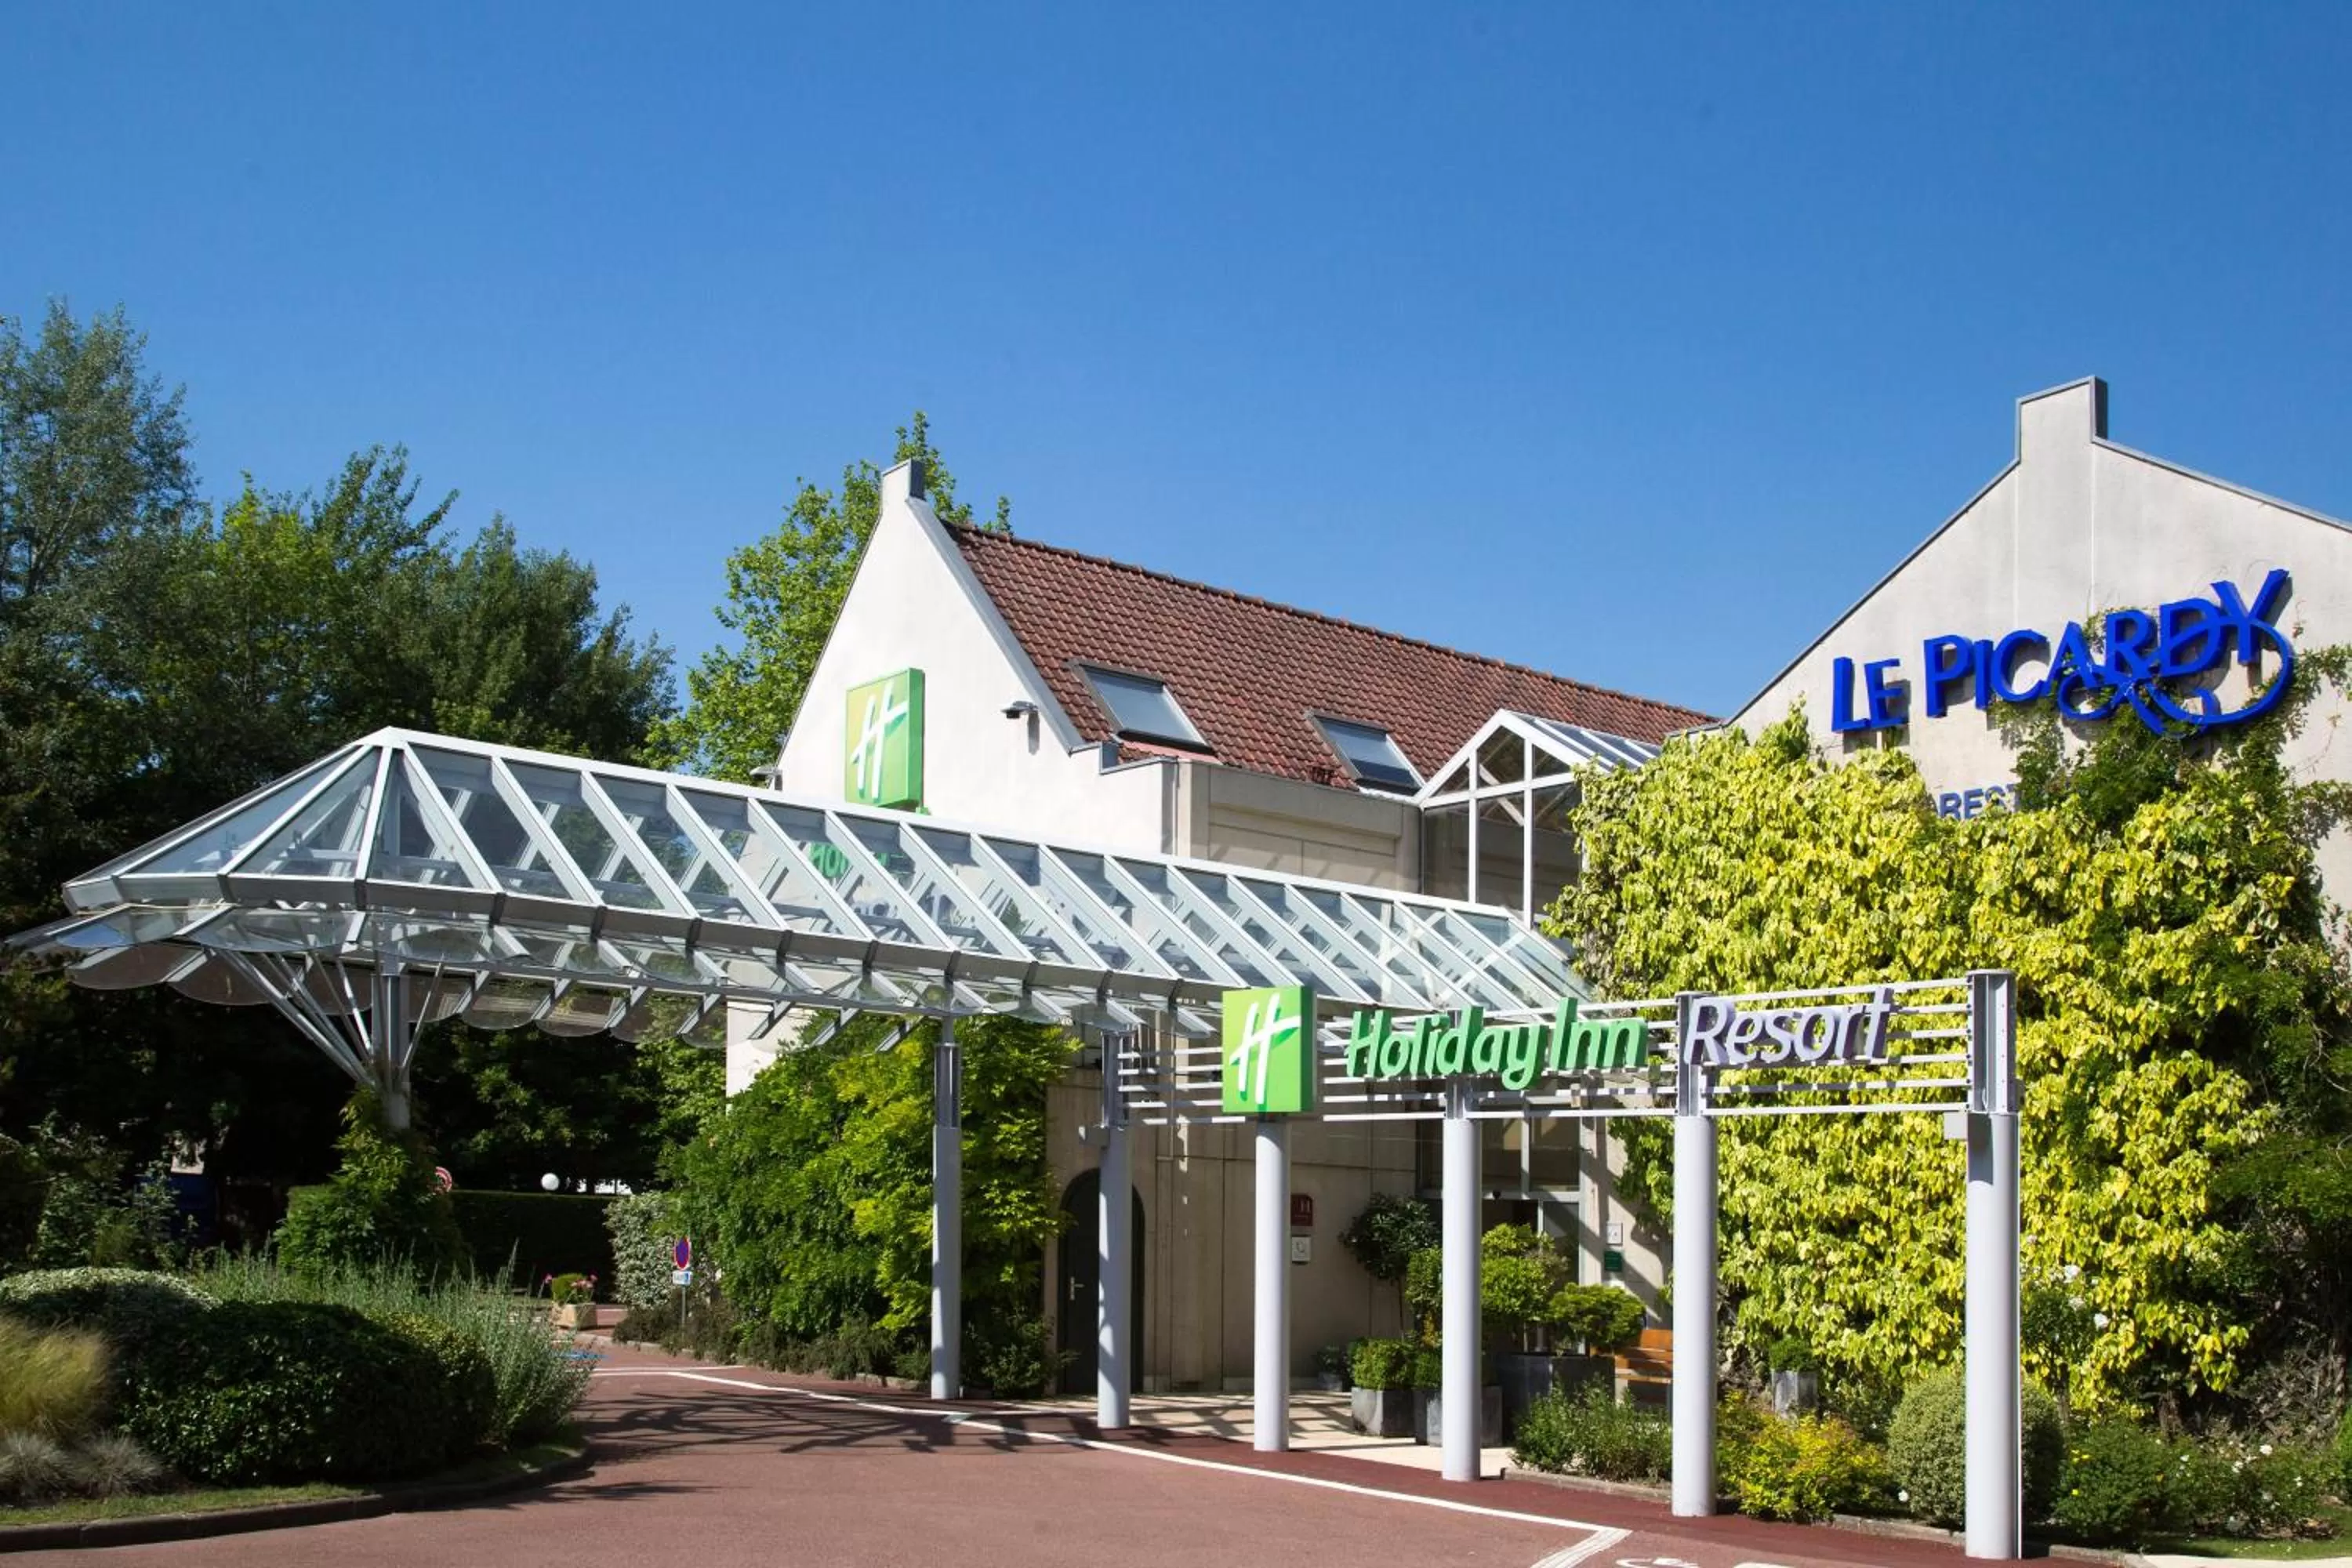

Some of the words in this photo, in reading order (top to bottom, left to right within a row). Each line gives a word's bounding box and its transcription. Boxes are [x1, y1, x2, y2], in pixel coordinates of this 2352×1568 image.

[1831, 656, 1909, 733] LE
[1923, 568, 2292, 735] PICARDY
[1345, 1005, 1548, 1091] Holiday
[1549, 996, 1649, 1071] Inn
[1684, 985, 1893, 1065] Resort
